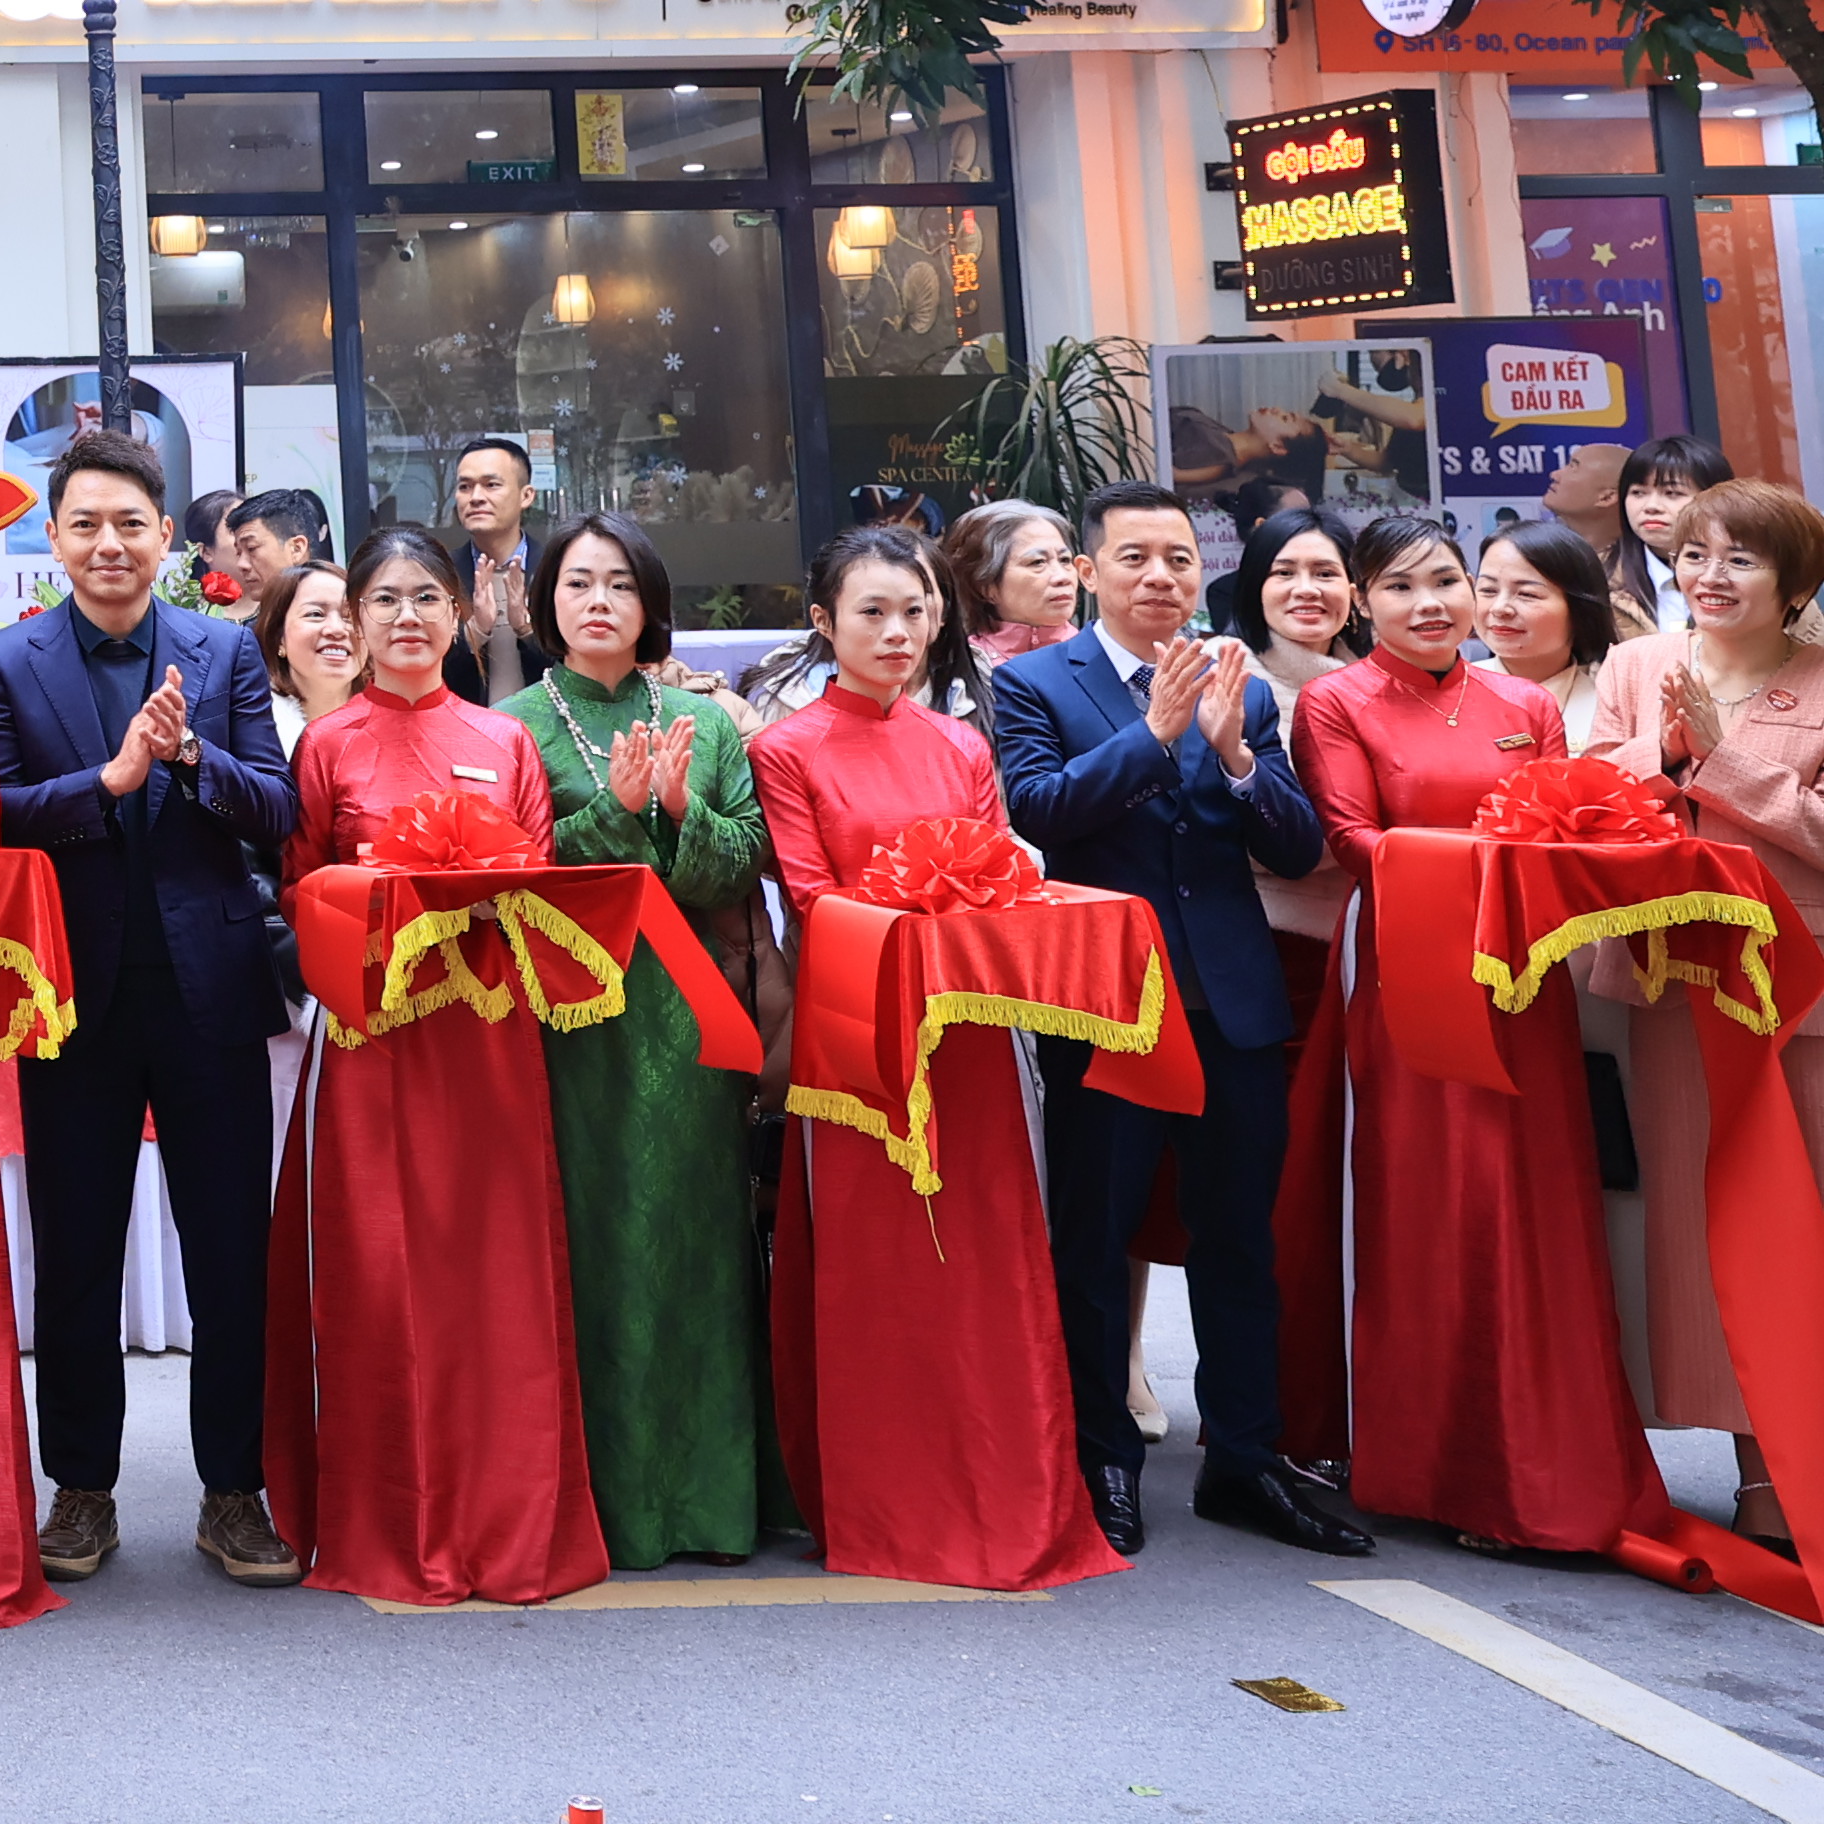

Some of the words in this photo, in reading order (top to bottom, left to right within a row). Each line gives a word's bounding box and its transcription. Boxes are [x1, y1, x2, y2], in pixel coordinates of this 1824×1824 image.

[1087, 2, 1137, 19] Beauty
[1514, 33, 1587, 52] Ocean
[488, 166, 536, 181] EXIT
[1242, 183, 1402, 252] MASSAGE
[1501, 361, 1547, 383] CAM
[1552, 353, 1590, 382] KẾT
[1511, 383, 1552, 411] ĐẦU
[1558, 389, 1585, 410] RA
[1469, 446, 1491, 475] &
[1499, 445, 1546, 474] SAT
[878, 466, 909, 483] SPA
